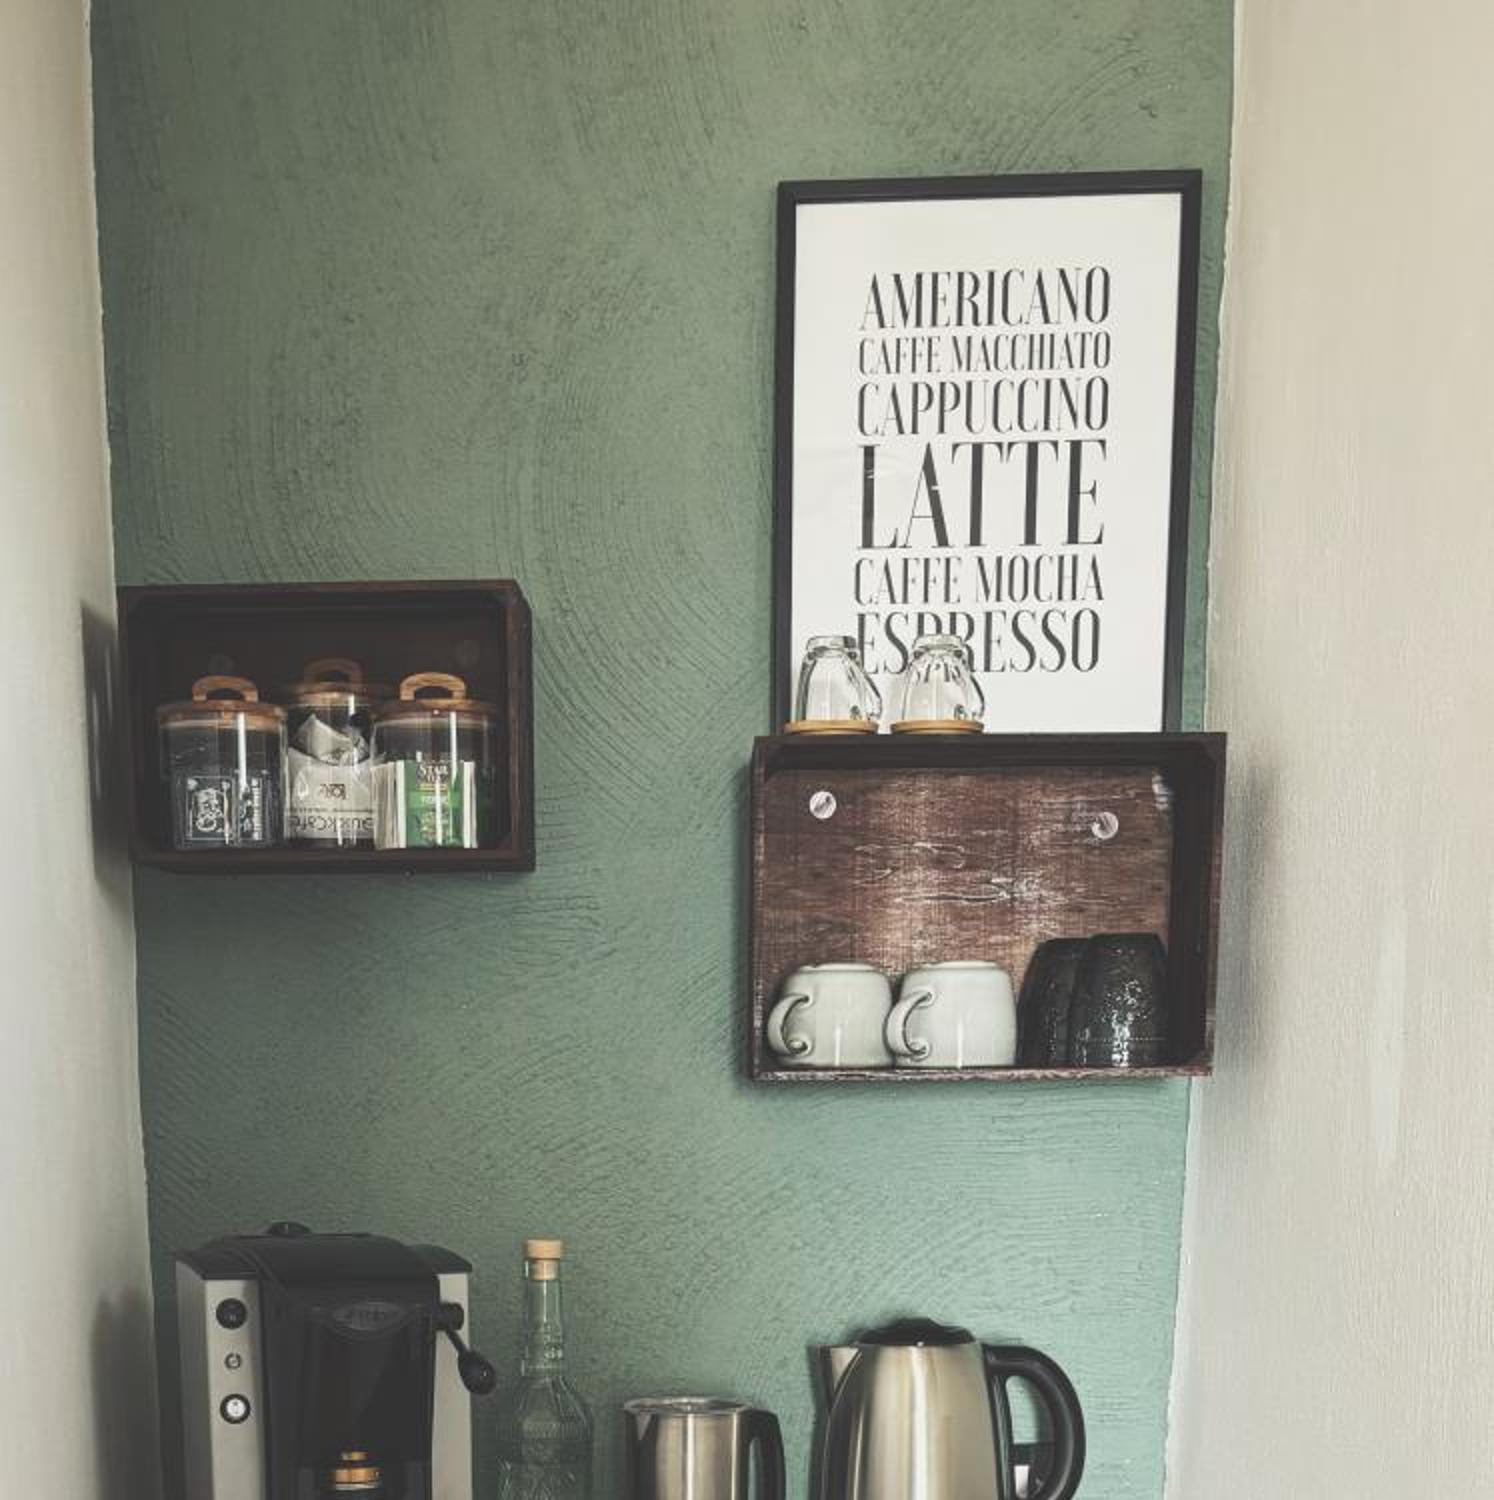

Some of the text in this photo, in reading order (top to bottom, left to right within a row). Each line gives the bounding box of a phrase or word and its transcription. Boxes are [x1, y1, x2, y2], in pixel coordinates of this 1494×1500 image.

[858, 266, 1111, 330] AMERICANO
[858, 331, 1111, 375] CAFFE MACCHIATO
[857, 376, 1110, 436] CAPPUCCINO
[856, 438, 1107, 549] LATTE
[854, 554, 1105, 605] CAFFE MOCHA
